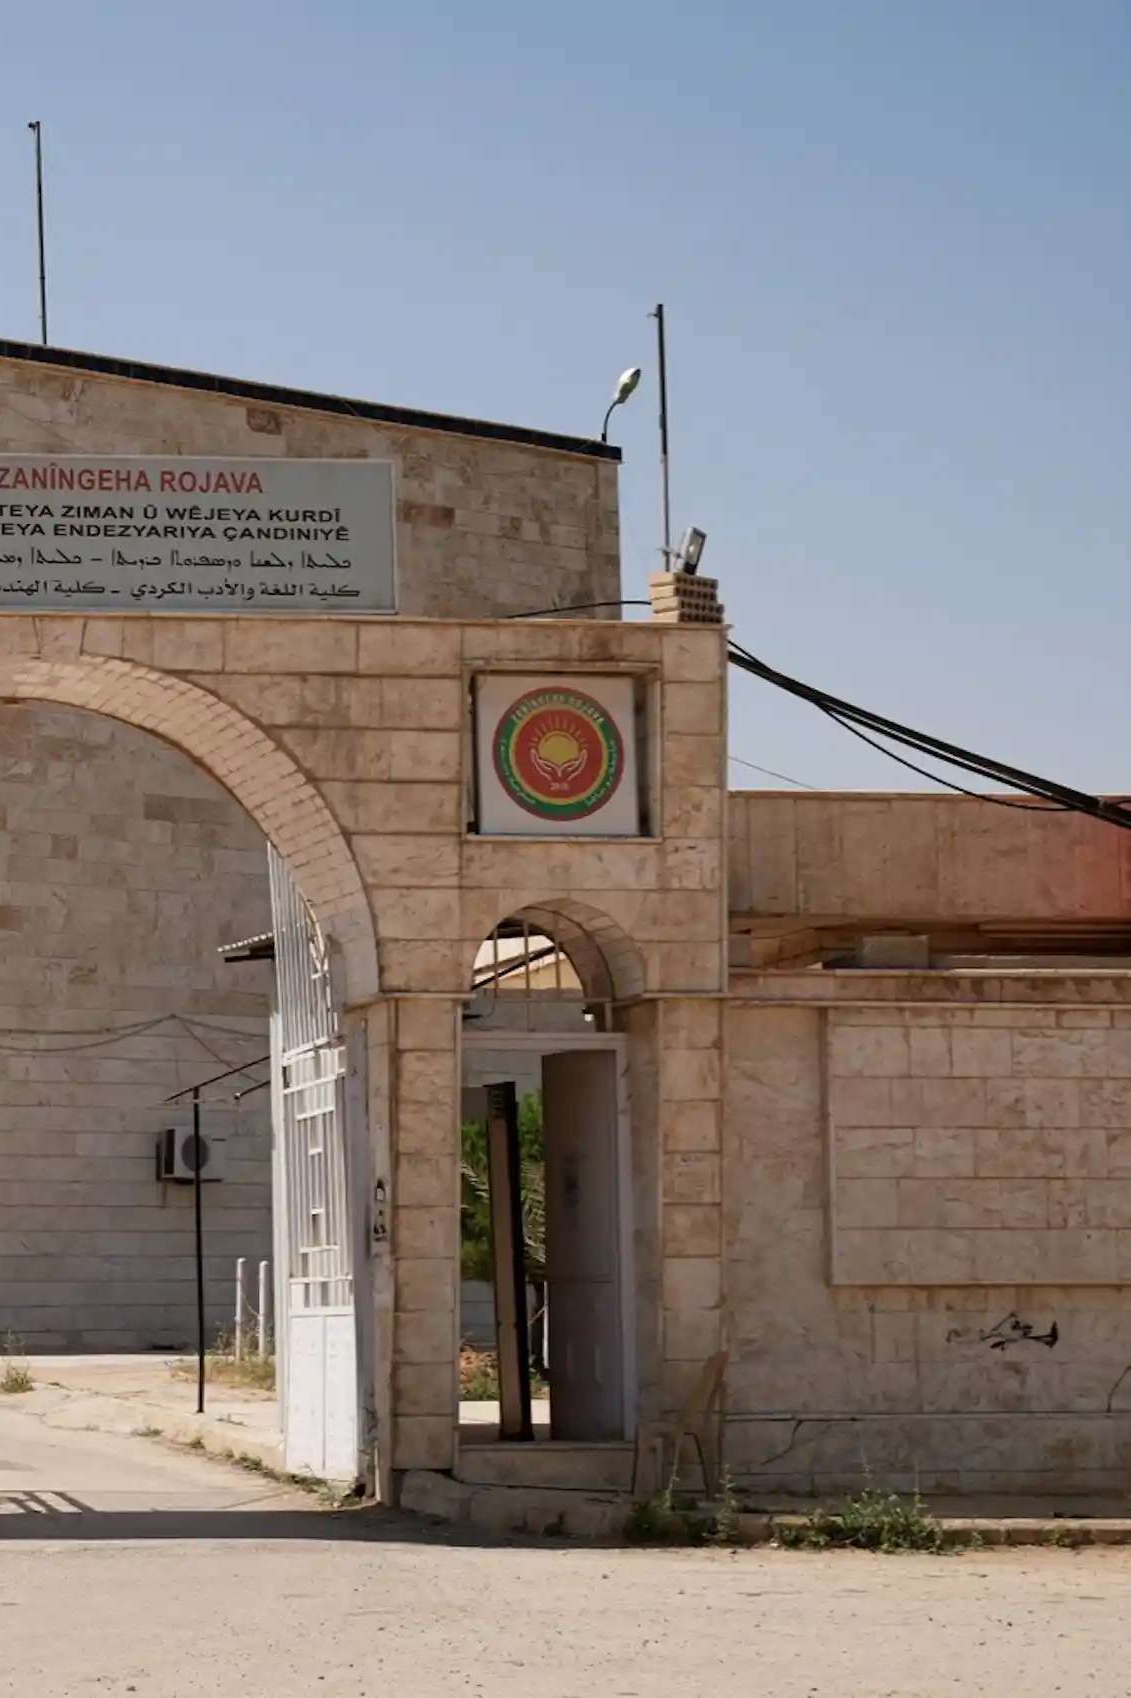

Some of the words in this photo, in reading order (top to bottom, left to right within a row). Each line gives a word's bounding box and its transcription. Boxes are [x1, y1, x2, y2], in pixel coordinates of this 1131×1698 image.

[160, 471, 263, 494] ROJAVA
[61, 505, 134, 520] ZIMAN
[143, 504, 158, 520] Û
[165, 505, 261, 521] WÊJEYA
[268, 508, 341, 523] KURDÎ
[53, 524, 217, 539] ENDEZYARIYA
[222, 526, 349, 542] ÇANDINIYÊ
[53, 580, 105, 597] كلية
[129, 582, 192, 601] الكردي
[197, 578, 255, 601] والأدب
[259, 582, 303, 596] اللغة
[308, 583, 361, 601] كلية
